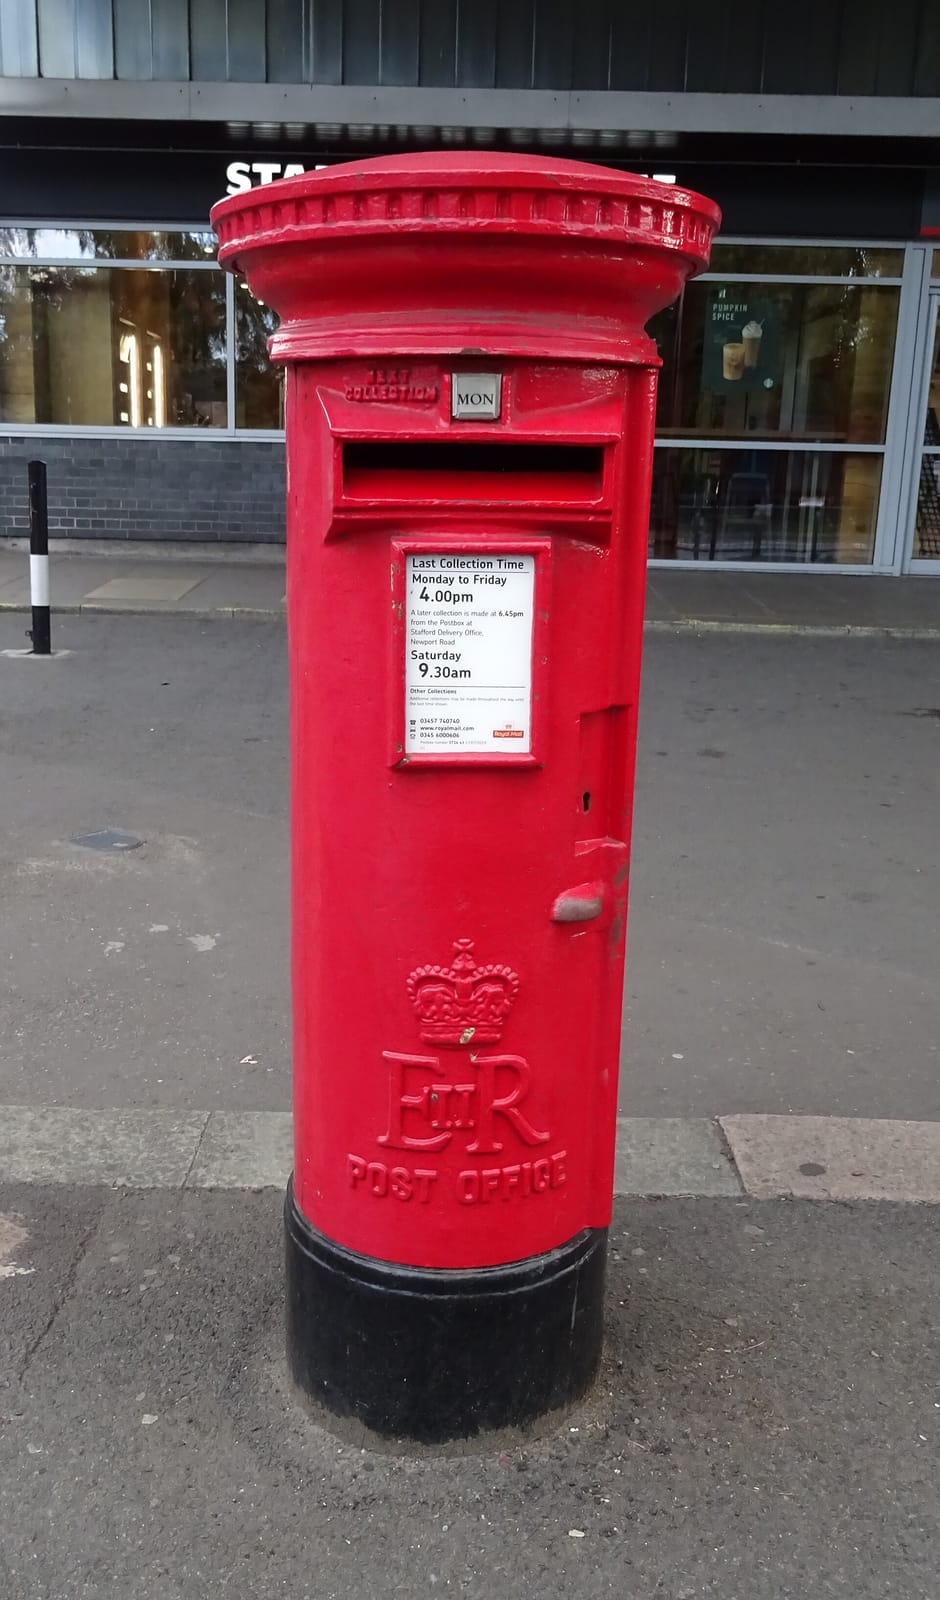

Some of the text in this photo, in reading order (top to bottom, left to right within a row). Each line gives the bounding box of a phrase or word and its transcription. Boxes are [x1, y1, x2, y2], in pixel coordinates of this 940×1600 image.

[712, 303, 748, 312] PUMPKIN
[712, 312, 735, 321] SPICE
[345, 385, 438, 402] COLLECTION
[457, 393, 494, 406] MON
[412, 557, 525, 570] Last Collection Time
[412, 573, 507, 587] Monday to Friday
[419, 586, 474, 605] 4.00pm
[498, 610, 525, 618] 6.45pm
[440, 619, 465, 627] Postbox
[438, 629, 463, 637] Delivery
[464, 629, 484, 637] Office,
[410, 638, 437, 646] Newport
[411, 649, 462, 662] Saturday
[418, 662, 472, 679] 9.30am
[346, 1150, 568, 1204] POST OFFICE
